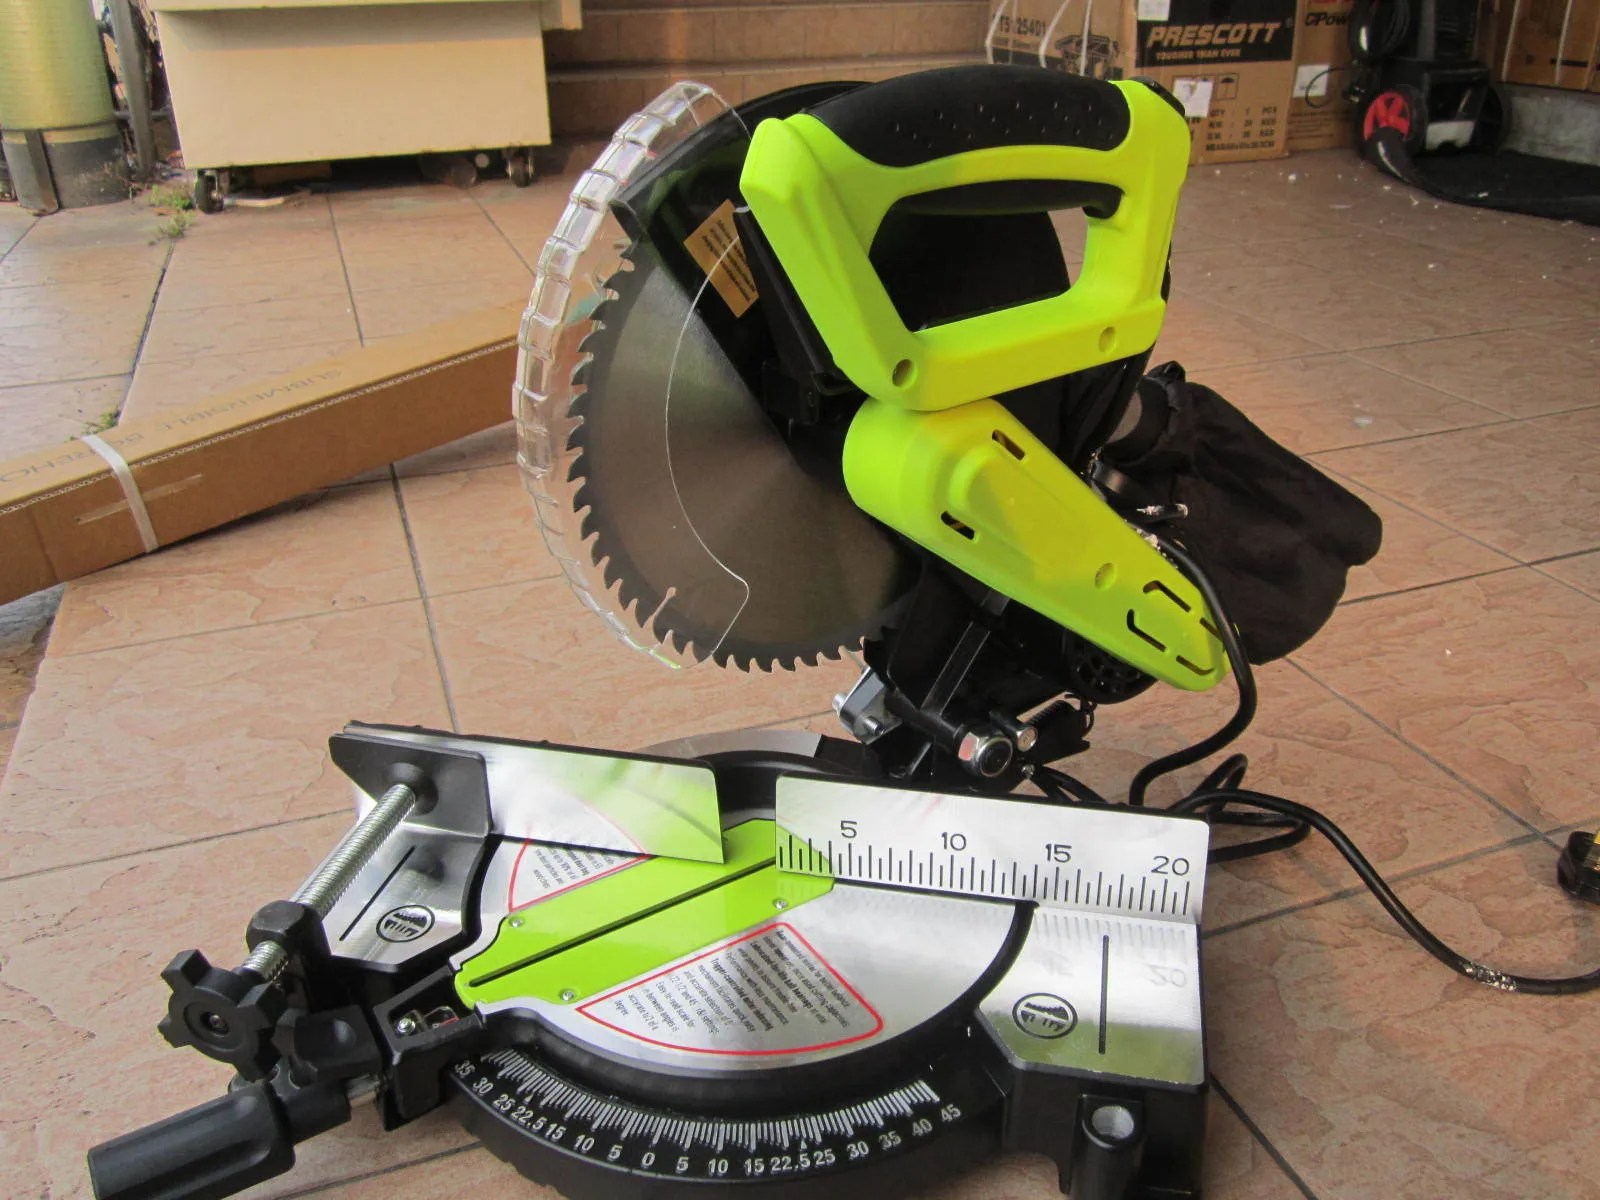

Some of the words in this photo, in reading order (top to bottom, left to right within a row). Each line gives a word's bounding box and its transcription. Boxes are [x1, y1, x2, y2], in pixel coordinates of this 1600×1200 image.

[1146, 22, 1282, 47] PRESCOTT
[1197, 50, 1218, 59] THAN
[1221, 49, 1240, 57] EVER
[840, 820, 858, 838] 5
[941, 831, 967, 851] 10
[1045, 843, 1072, 863] 15
[1151, 855, 1190, 876] 20
[473, 1077, 494, 1094] 30
[493, 1094, 516, 1111] 25
[511, 1106, 548, 1130] 22.5
[545, 1123, 567, 1140] 15
[575, 1134, 595, 1151] 10
[608, 1145, 623, 1160] 5
[641, 1152, 656, 1167] 0
[676, 1156, 689, 1171] 5
[708, 1159, 729, 1174] 10
[745, 1158, 765, 1174] 15
[770, 1153, 811, 1172] 22.5
[813, 1149, 836, 1166] 25
[847, 1141, 869, 1158] 30
[879, 1131, 902, 1148] 35
[912, 1118, 933, 1136] 40
[940, 1104, 961, 1121] 45
